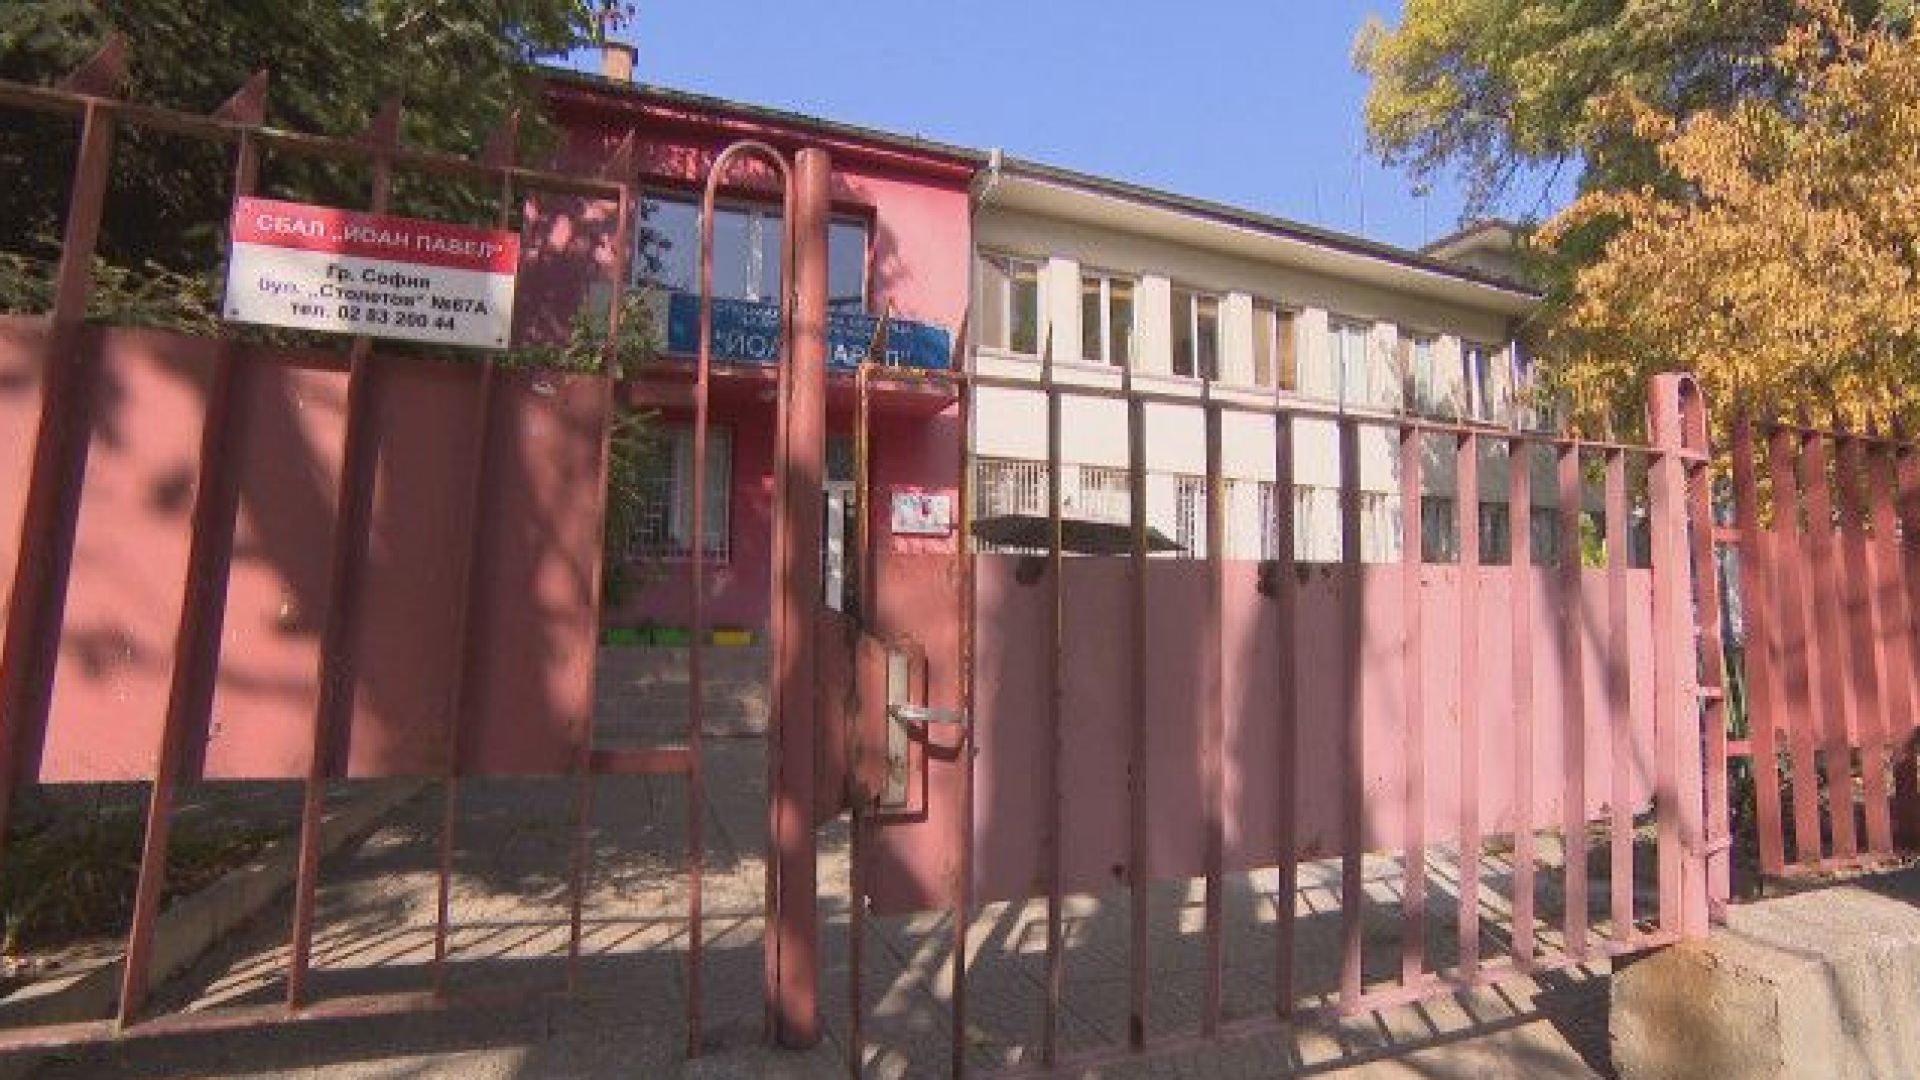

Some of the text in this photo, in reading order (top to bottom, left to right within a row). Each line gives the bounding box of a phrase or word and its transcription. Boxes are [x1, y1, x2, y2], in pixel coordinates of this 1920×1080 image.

[257, 214, 324, 237] СБАЛ
[326, 263, 430, 290] Гр. София
[338, 305, 360, 321] 02
